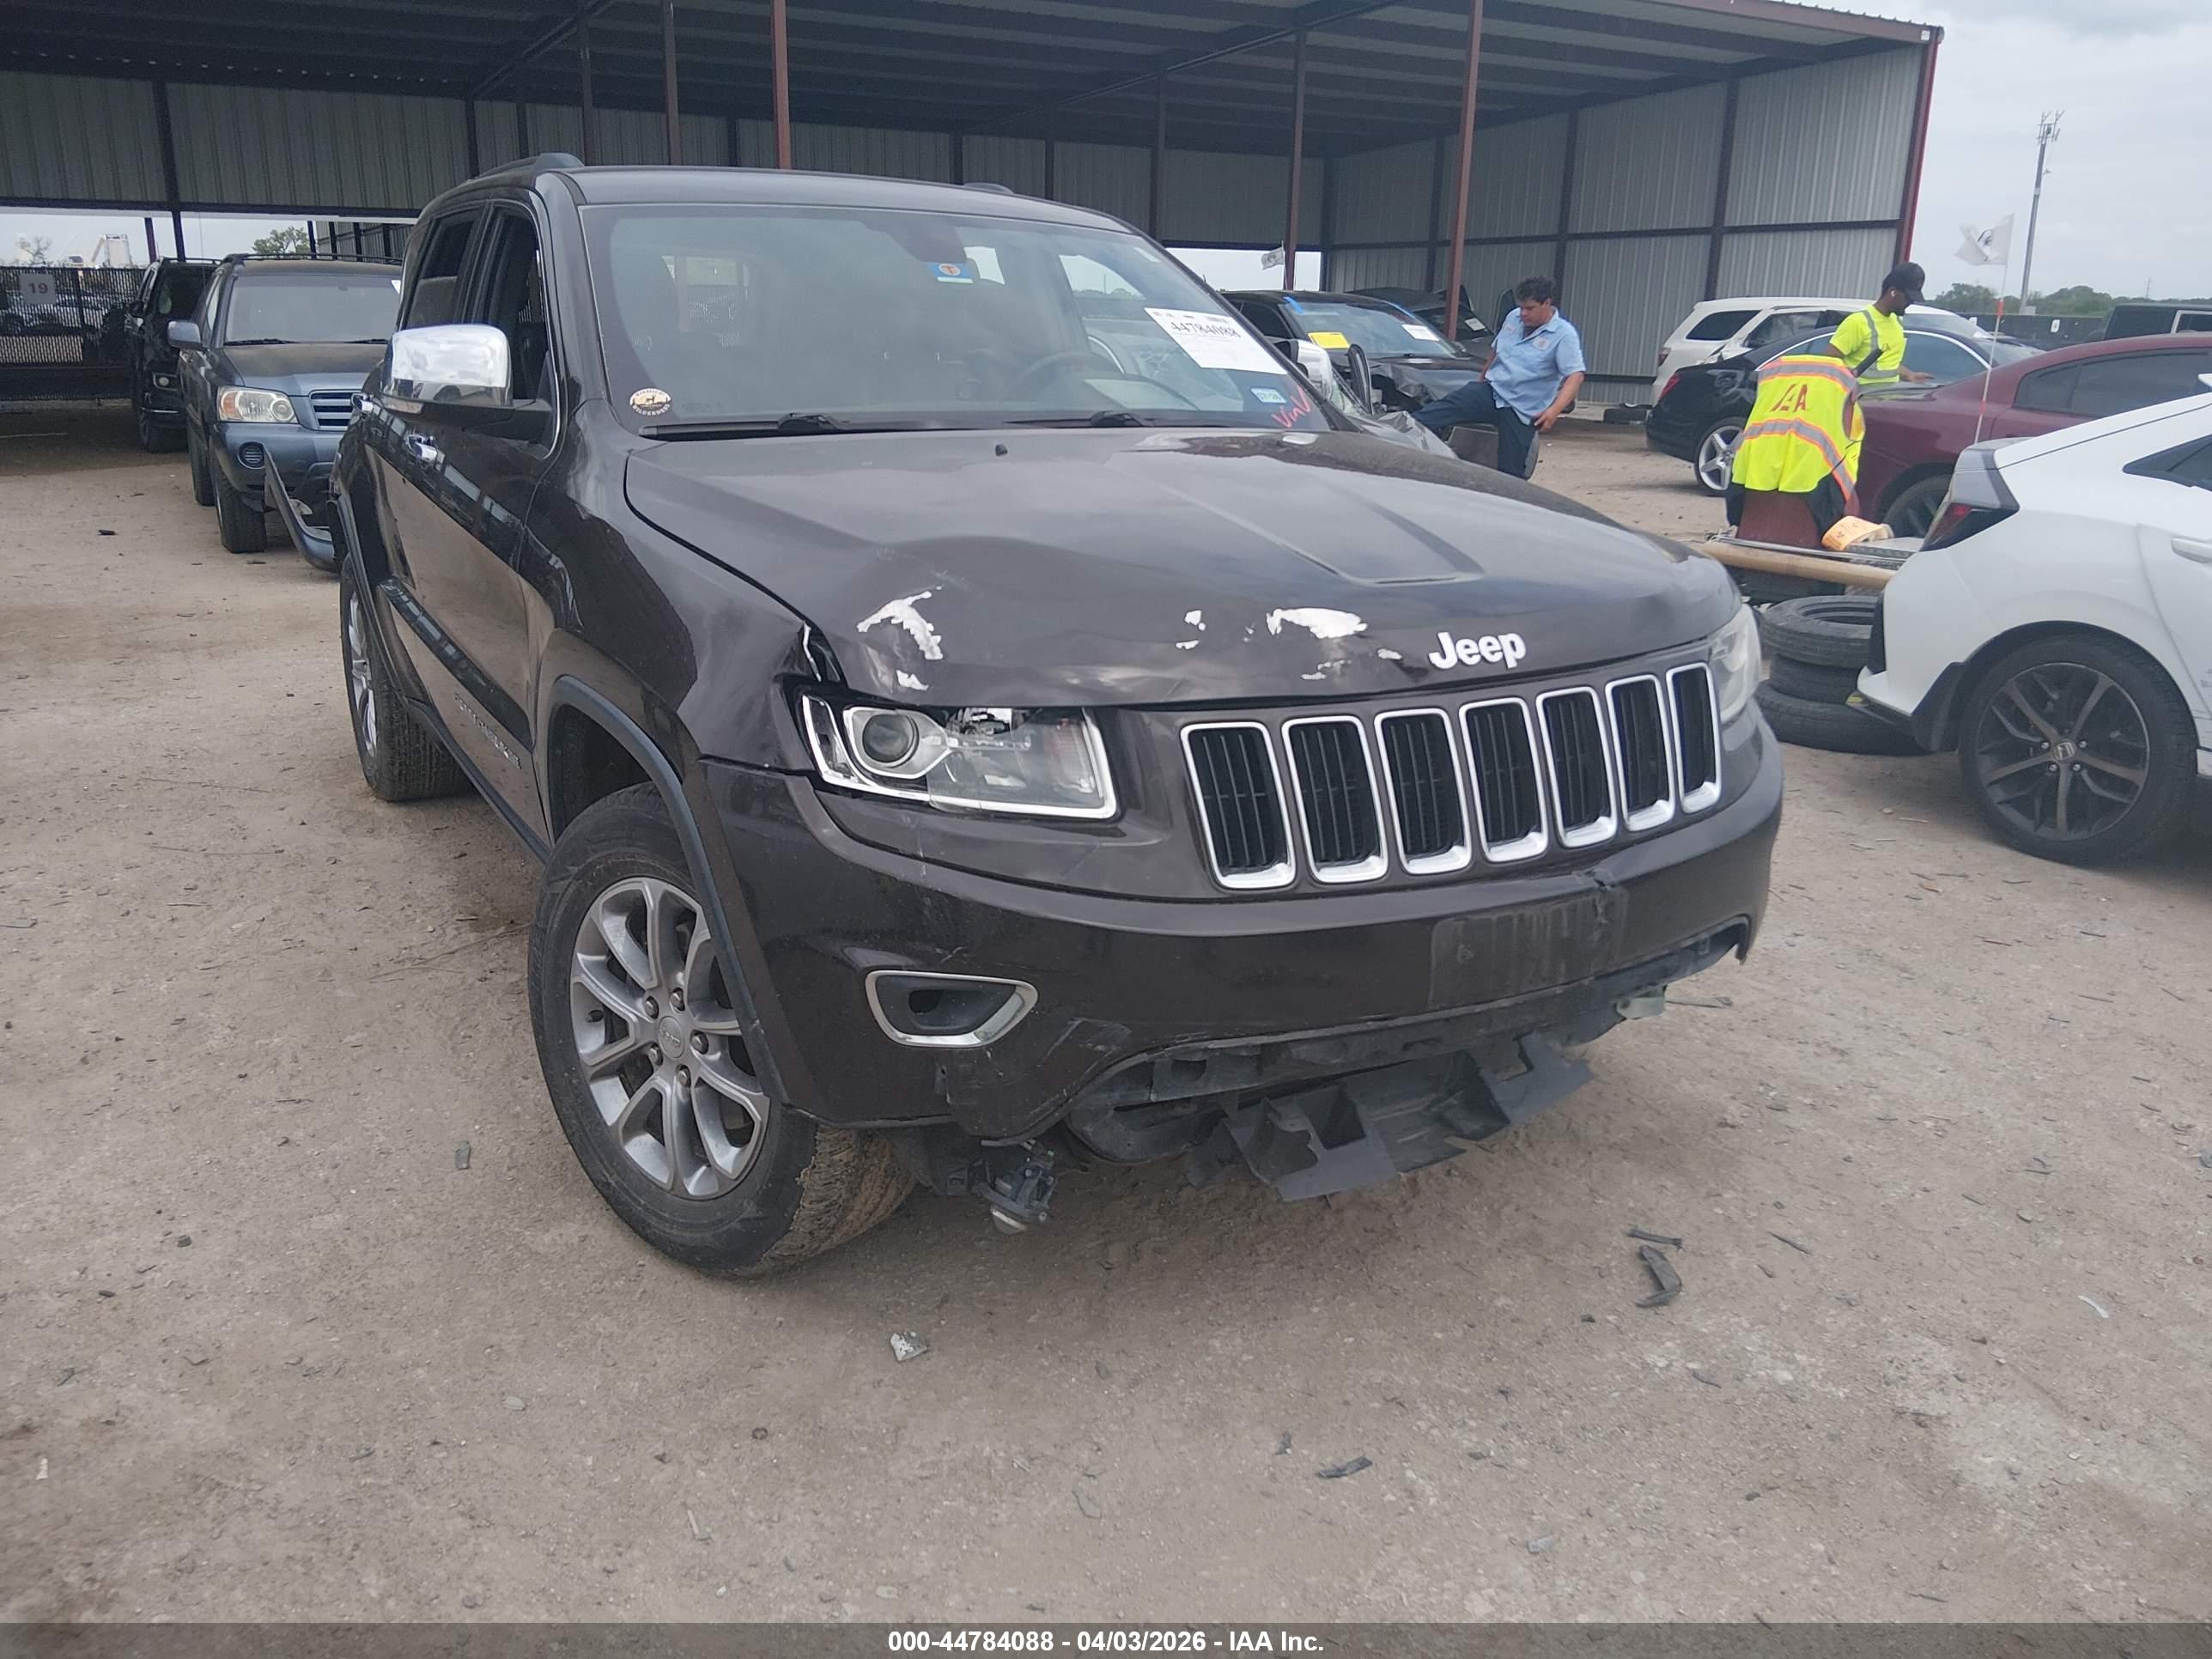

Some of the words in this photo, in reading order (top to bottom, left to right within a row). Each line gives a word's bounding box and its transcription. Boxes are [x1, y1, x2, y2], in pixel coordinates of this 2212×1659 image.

[27, 283, 48, 294] 19
[1170, 321, 1242, 338] 44784088
[1428, 631, 1527, 670] Jeep
